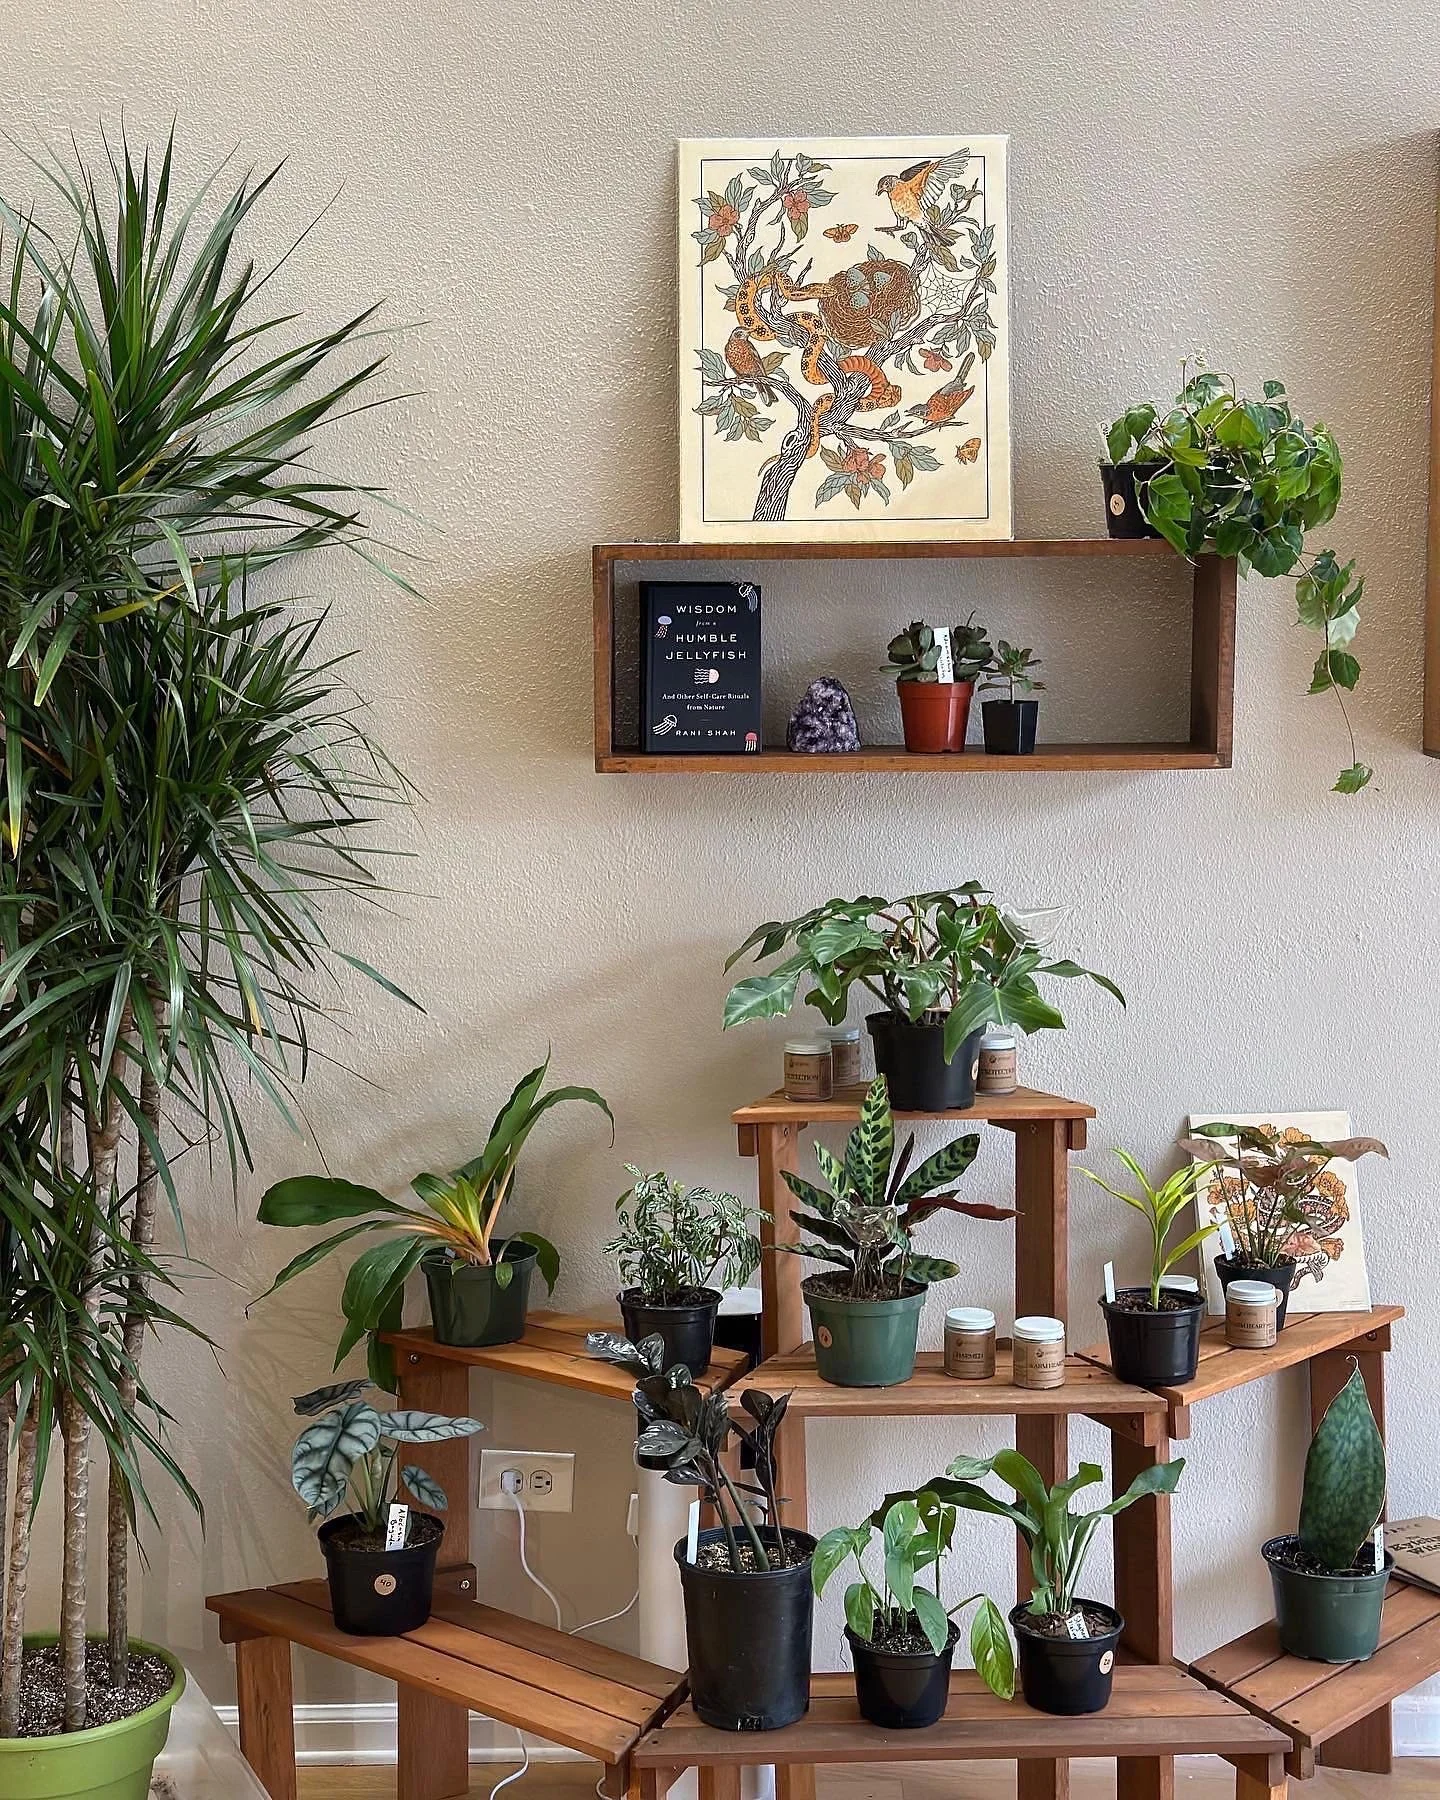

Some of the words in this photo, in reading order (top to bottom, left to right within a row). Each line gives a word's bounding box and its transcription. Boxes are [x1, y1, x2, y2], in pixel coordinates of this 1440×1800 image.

[676, 605, 737, 614] WISDOM
[695, 620, 710, 628] from
[676, 633, 737, 643] HUMBLE
[665, 651, 746, 660] JELLYFISH
[727, 692, 750, 700] Rituals
[380, 1579, 392, 1588] 40
